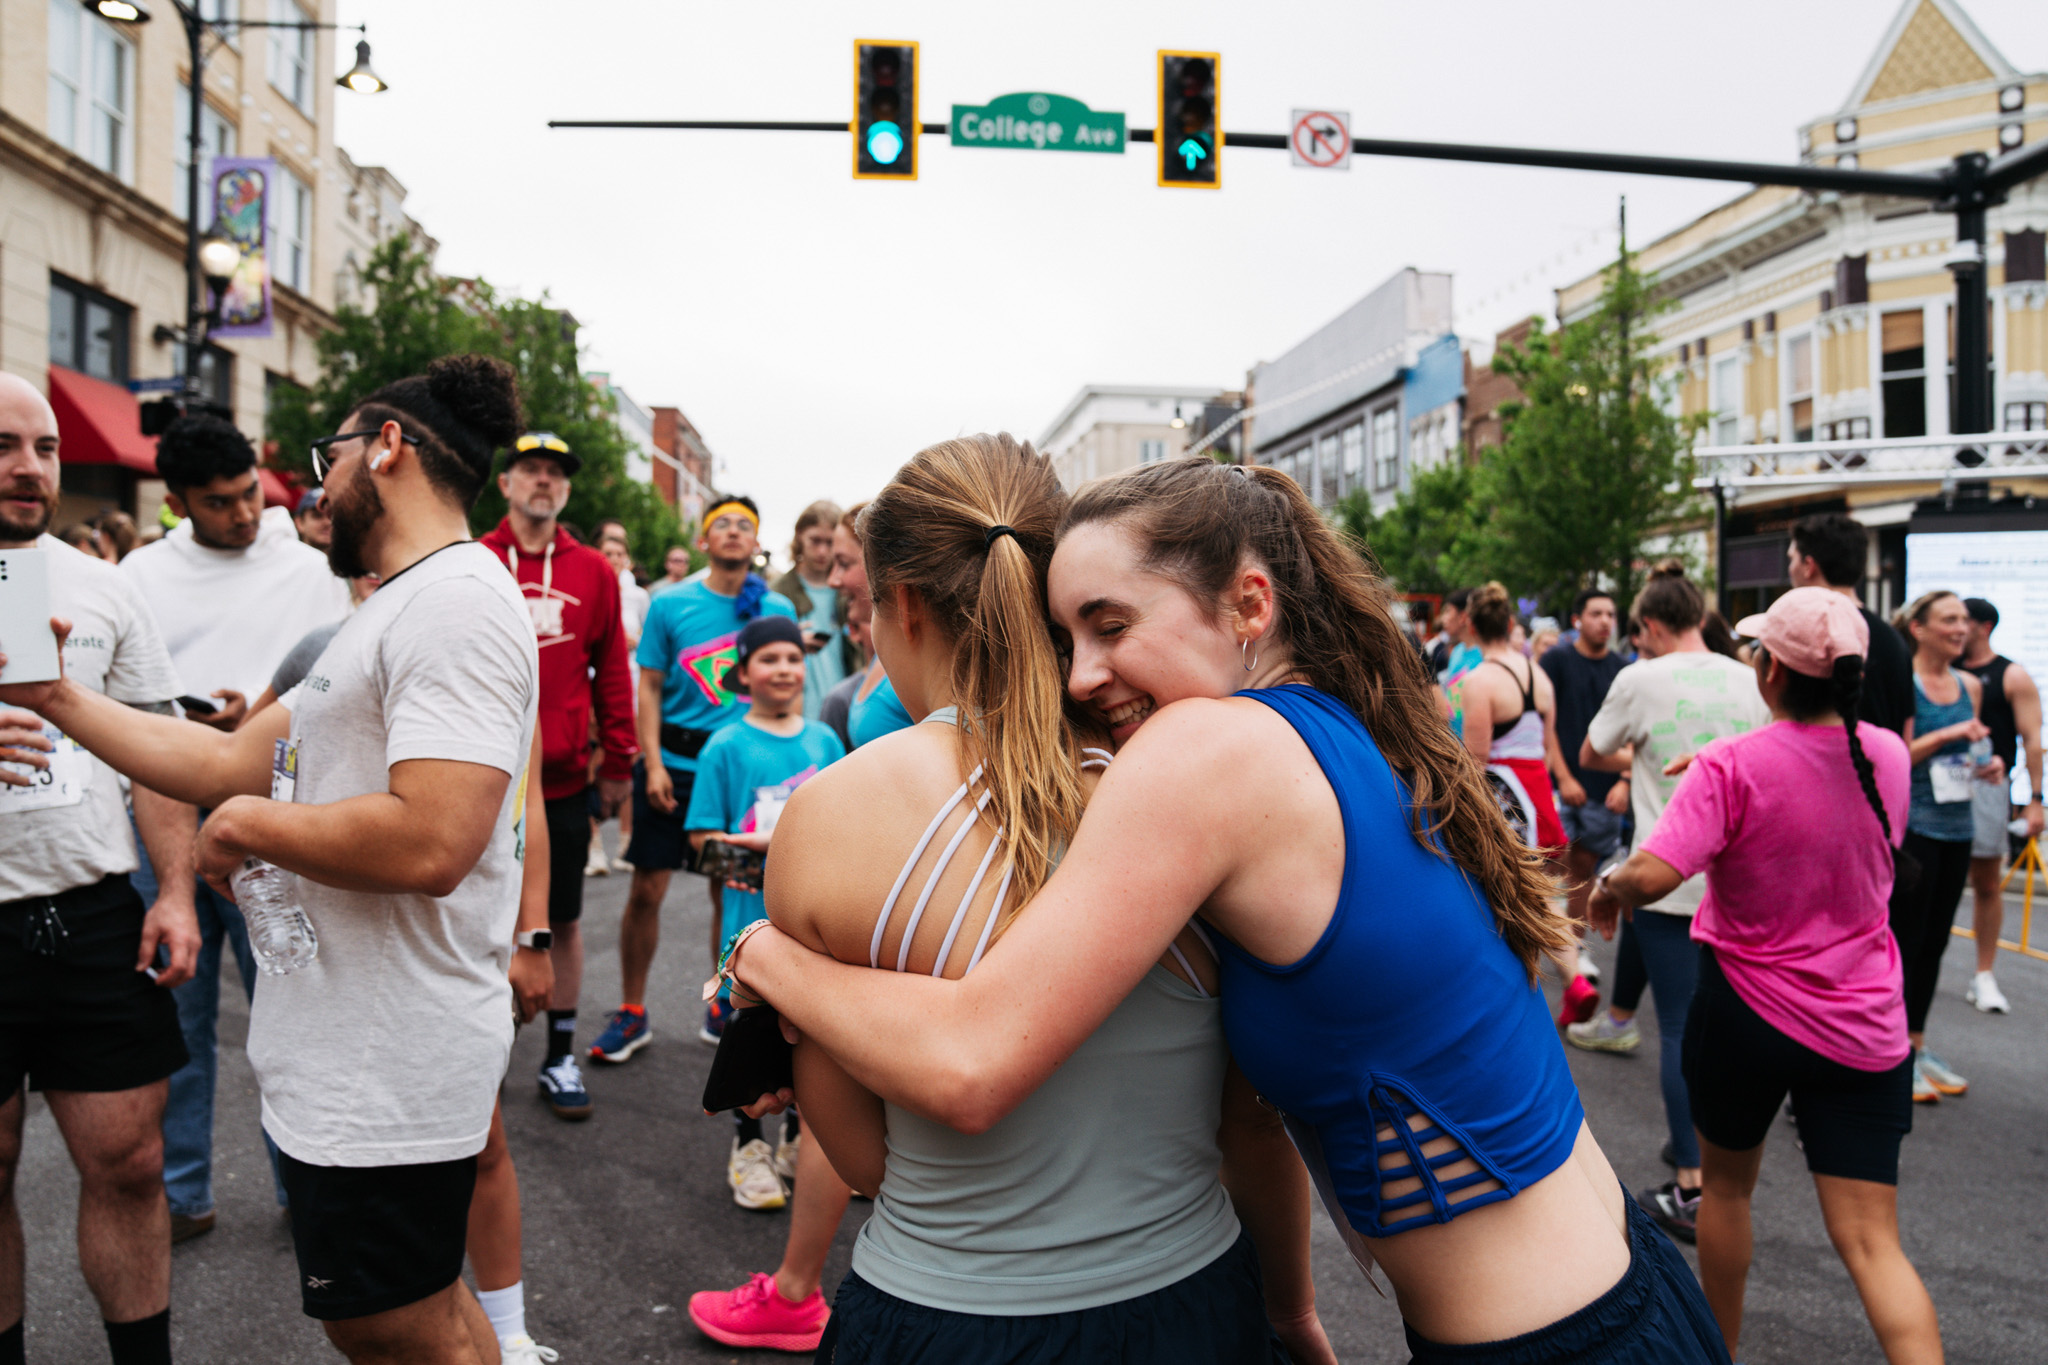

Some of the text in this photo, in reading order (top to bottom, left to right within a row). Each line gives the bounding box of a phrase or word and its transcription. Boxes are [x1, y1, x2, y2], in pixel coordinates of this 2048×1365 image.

[960, 113, 1117, 149] College Ave
[64, 636, 104, 649] erate
